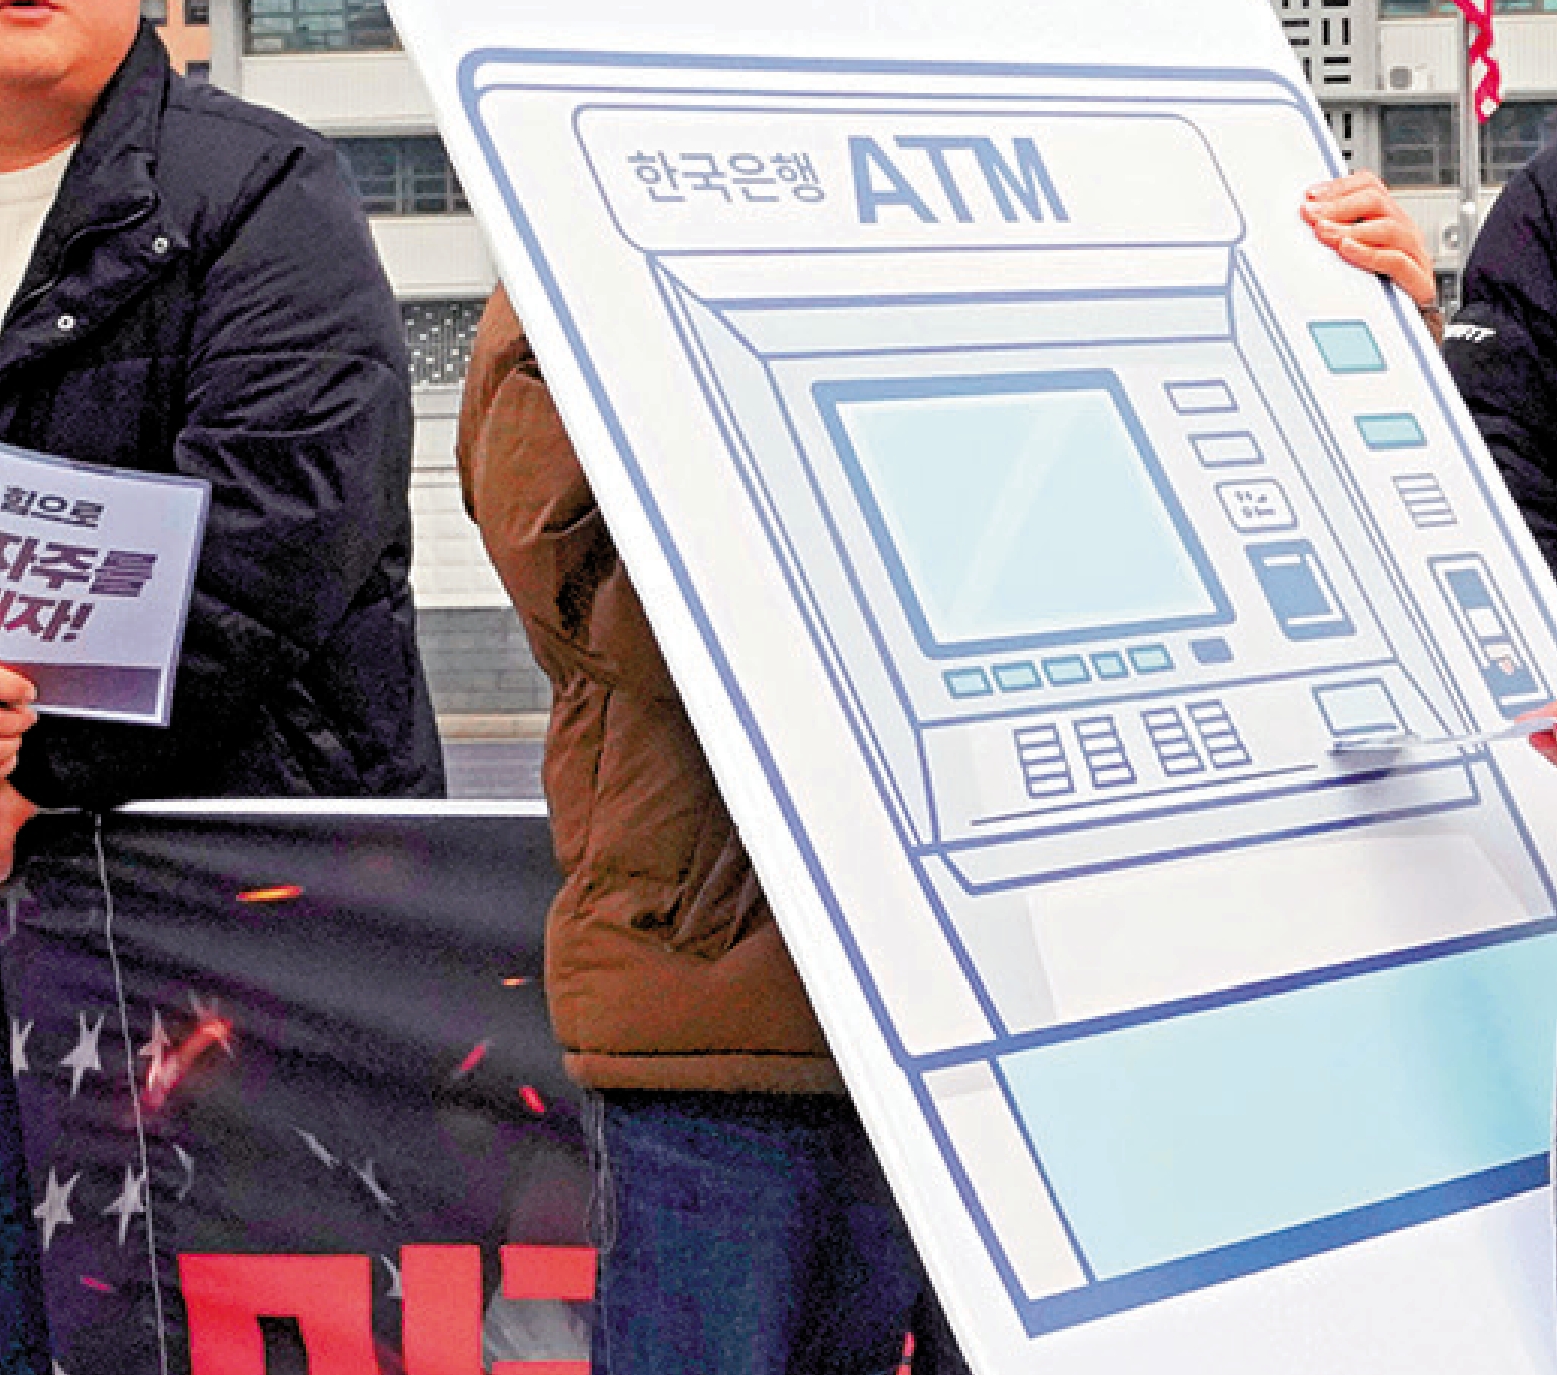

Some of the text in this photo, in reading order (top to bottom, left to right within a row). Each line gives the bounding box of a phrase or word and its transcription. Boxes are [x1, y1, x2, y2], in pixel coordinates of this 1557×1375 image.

[627, 134, 1072, 224] 한국은행 ATM
[1, 486, 105, 528] 힘으로
